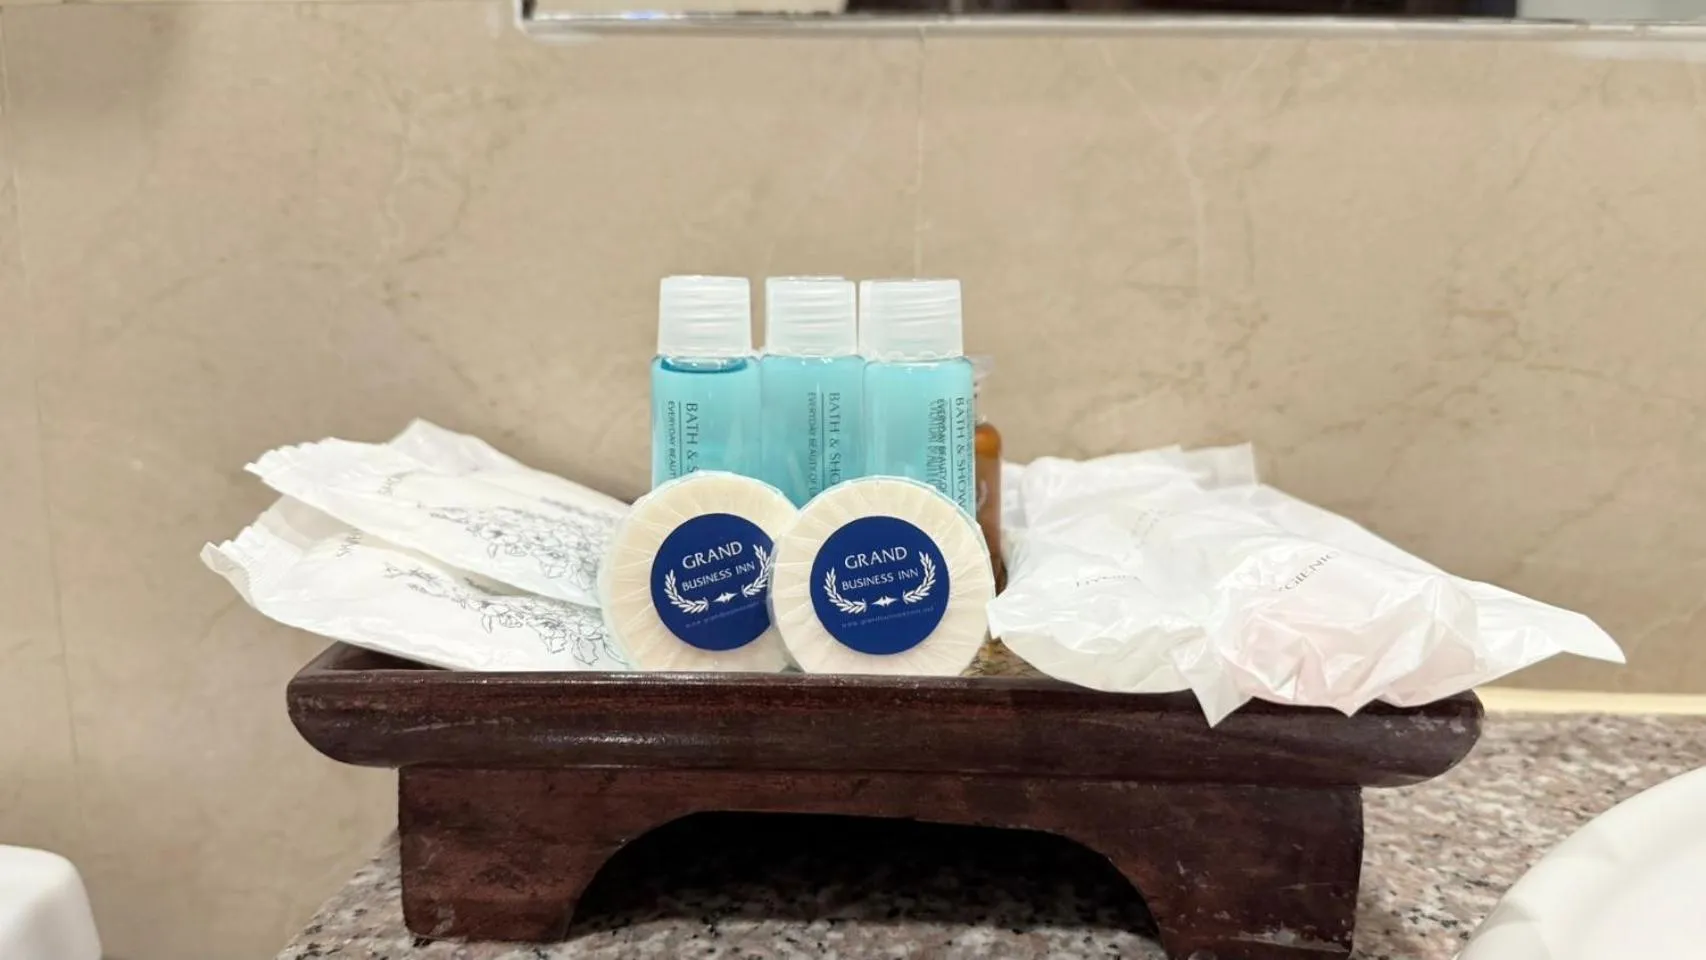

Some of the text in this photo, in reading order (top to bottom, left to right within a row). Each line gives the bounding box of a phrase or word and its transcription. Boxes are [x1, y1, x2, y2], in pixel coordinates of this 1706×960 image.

[808, 392, 817, 436] EVERYDAY
[937, 399, 947, 444] EVERYDAY
[668, 400, 677, 479] EVERYDAY BEAUT
[686, 403, 700, 474] BATH & S
[808, 438, 817, 470] BEAUTY
[829, 392, 841, 486] BATH & SHO
[955, 397, 967, 508] BATH & SHOW
[938, 445, 948, 481] BEAUTY
[682, 541, 743, 569] GRAND
[844, 546, 908, 569] GRAND
[681, 561, 756, 591] BUSINESS INN
[841, 567, 919, 590] BUSINESS INN
